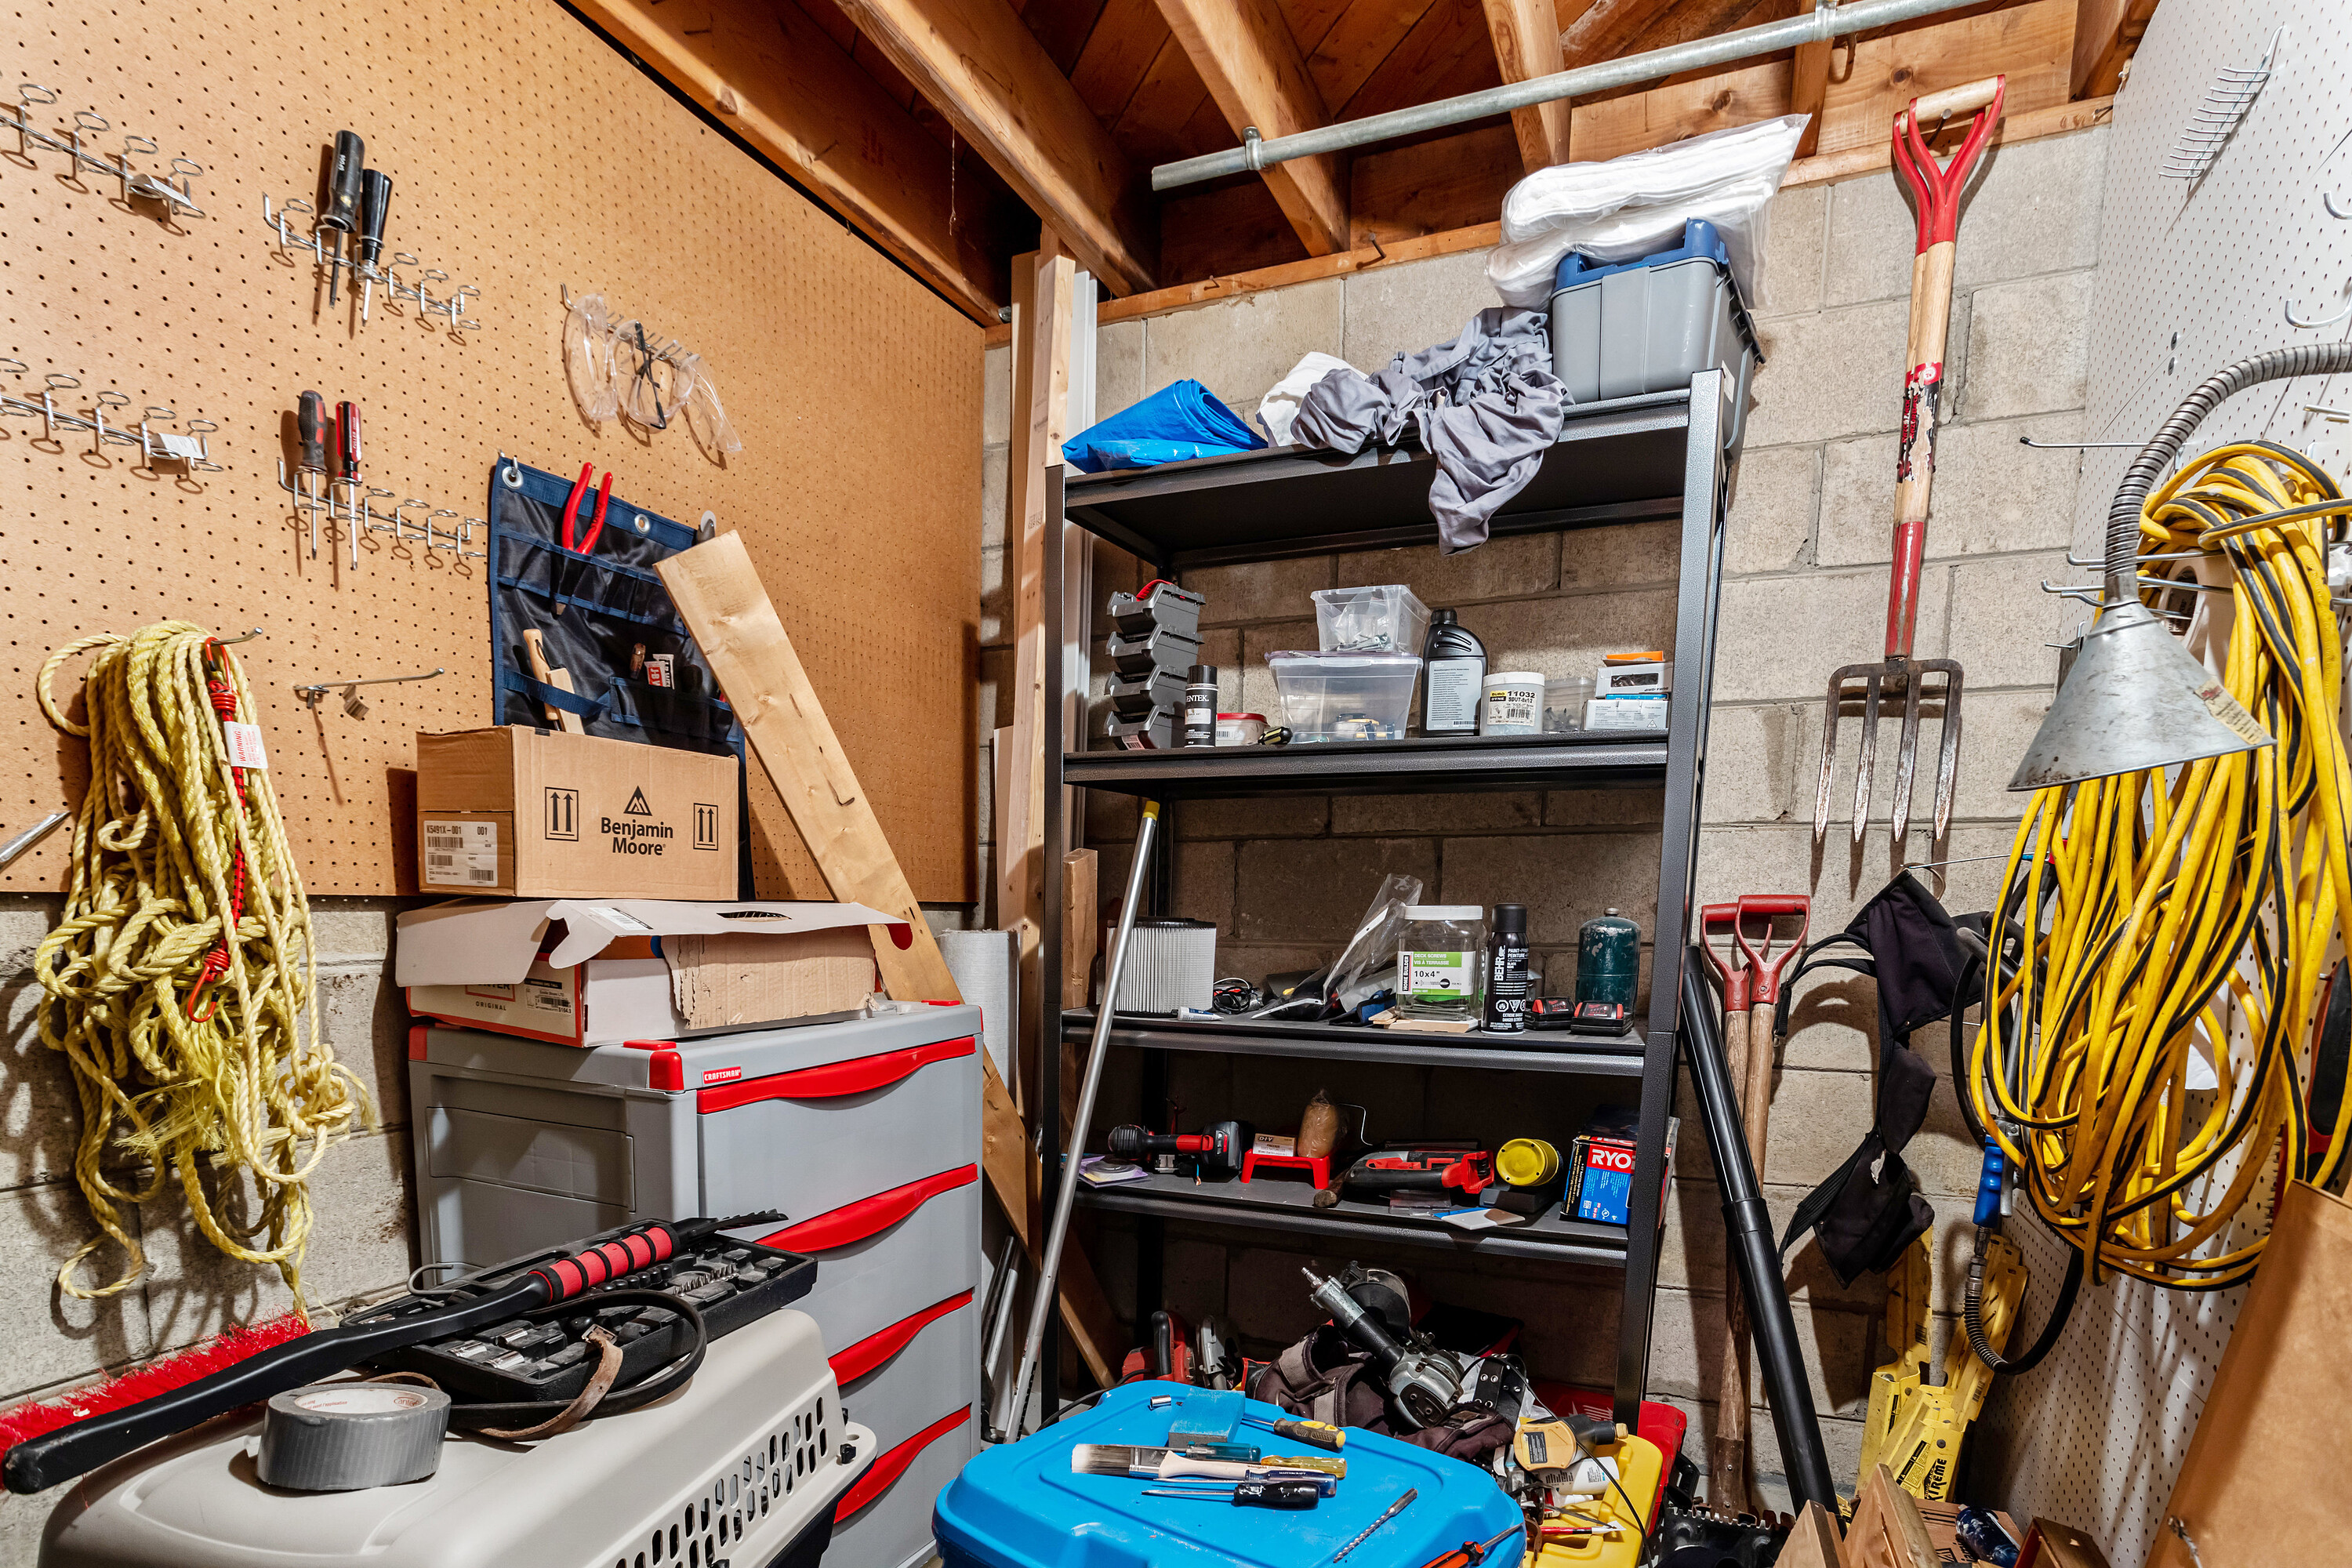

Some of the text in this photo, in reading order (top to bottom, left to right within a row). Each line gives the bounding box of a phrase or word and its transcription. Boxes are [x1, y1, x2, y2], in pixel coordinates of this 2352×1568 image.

[234, 731, 246, 761] WARNING
[477, 826, 488, 836] 001
[601, 817, 673, 840] Benjamin
[612, 837, 663, 856] Moore
[1494, 956, 1504, 981] BEHR
[475, 1001, 506, 1011] ORIGINAL
[704, 1069, 739, 1081] CRAFTSMAN
